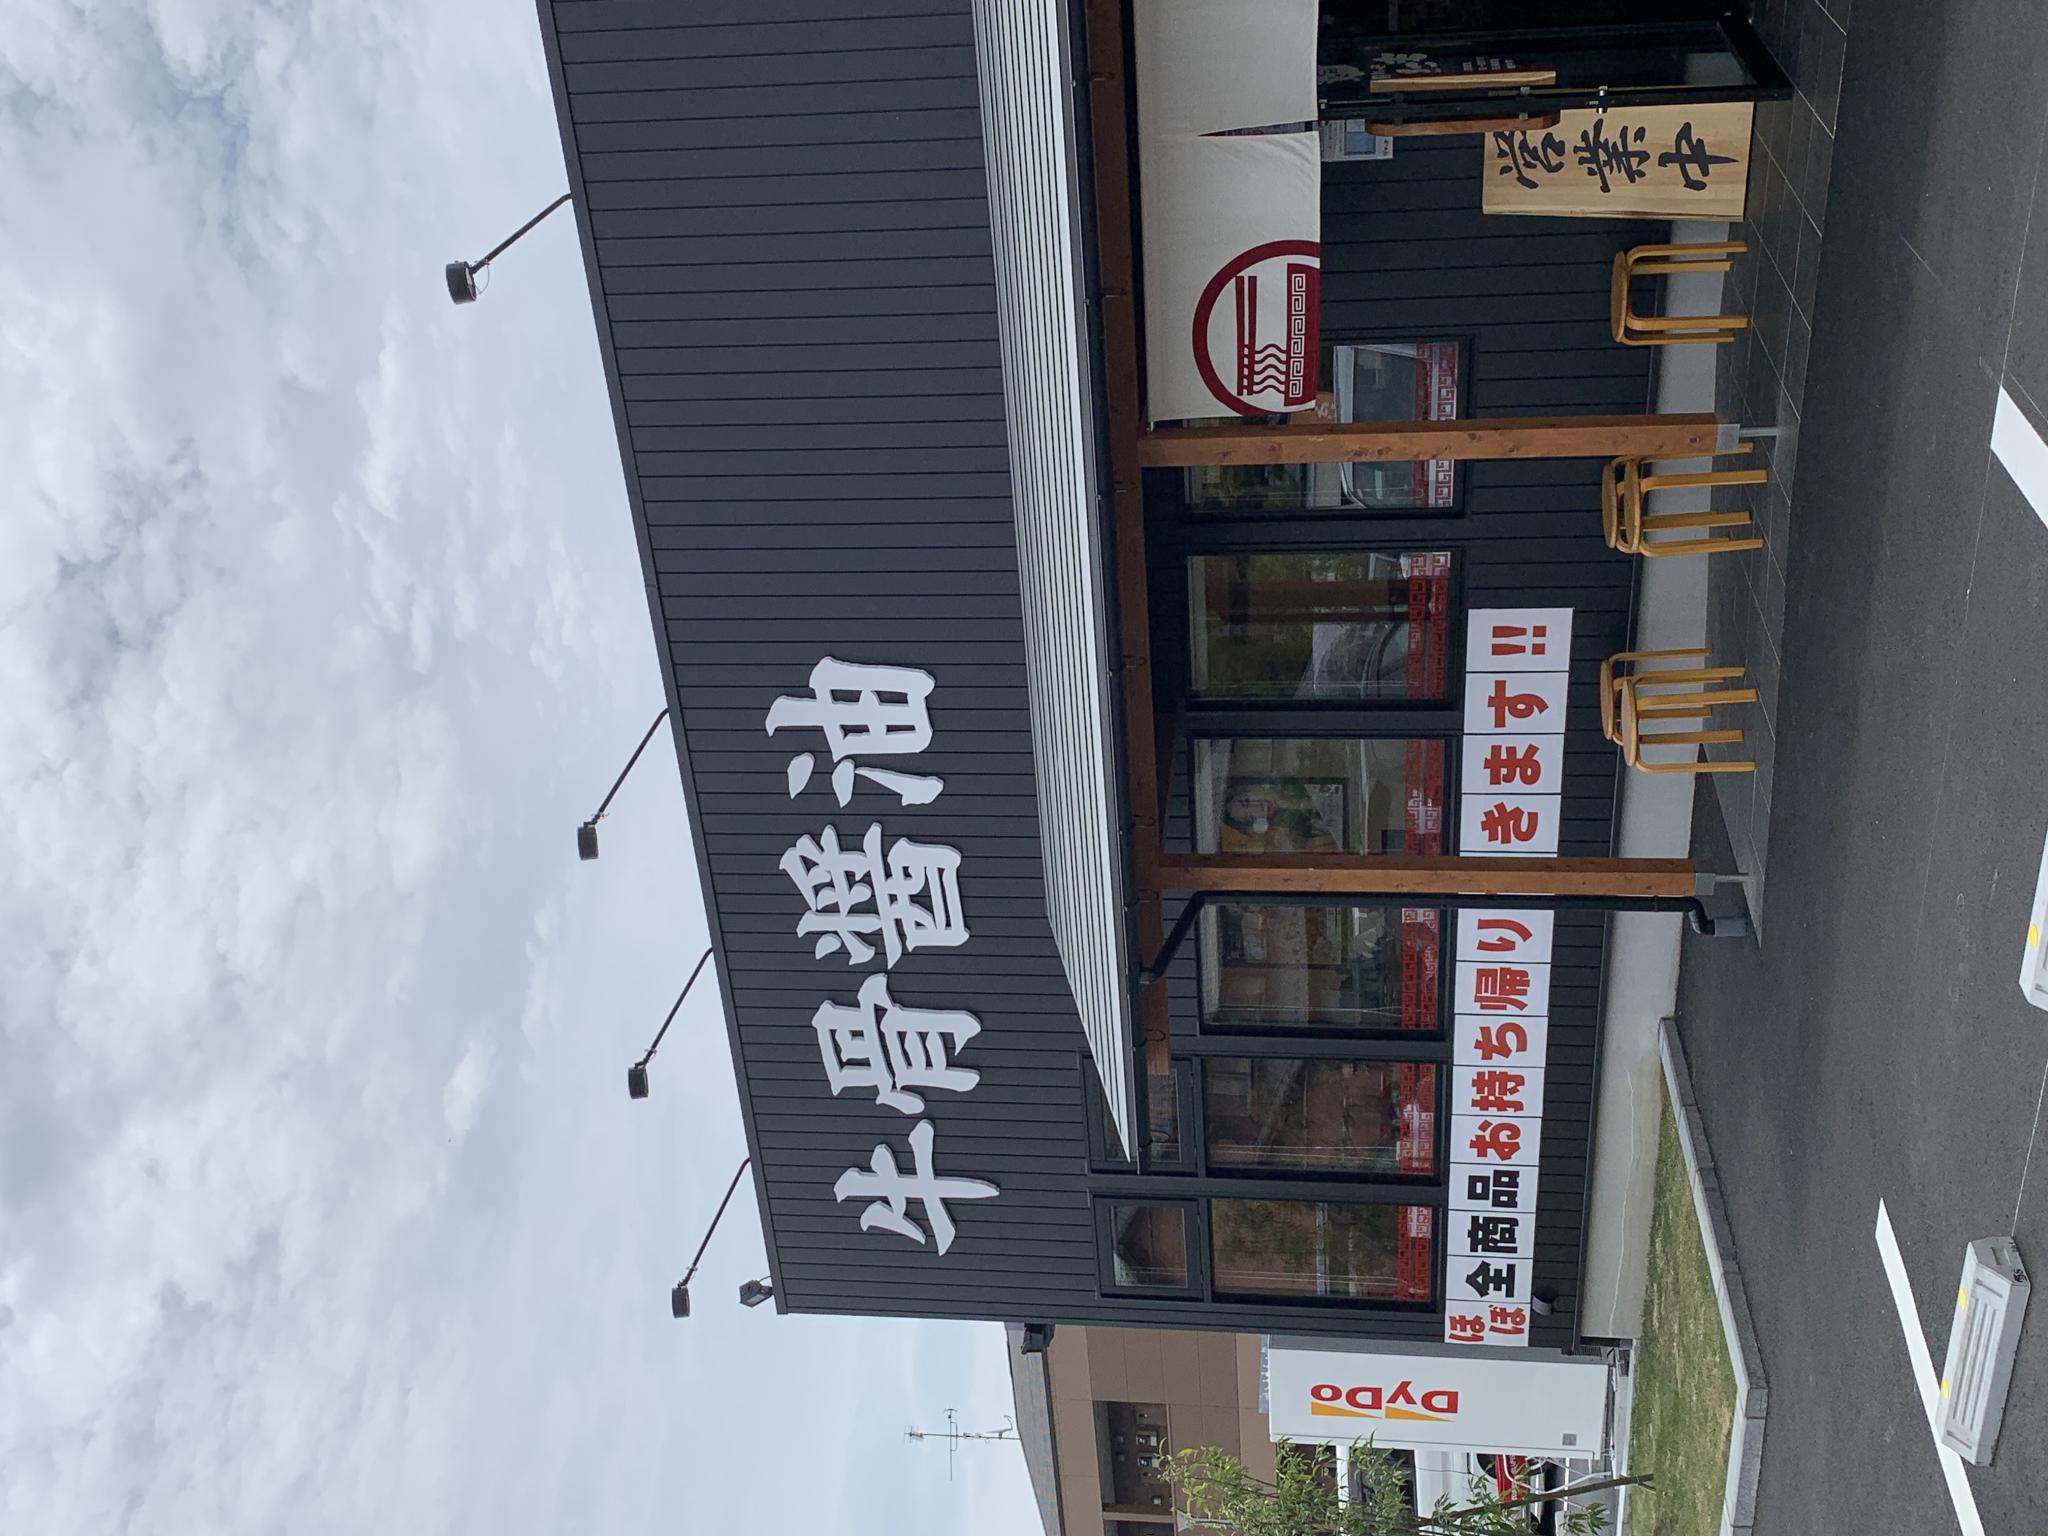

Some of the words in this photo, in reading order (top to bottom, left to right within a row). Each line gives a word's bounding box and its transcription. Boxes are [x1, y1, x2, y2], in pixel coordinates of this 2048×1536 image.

[1493, 118, 1739, 193] 営業中
[765, 656, 999, 1255] 牛骨醤油
[1448, 1304, 1526, 1342] ほぼ
